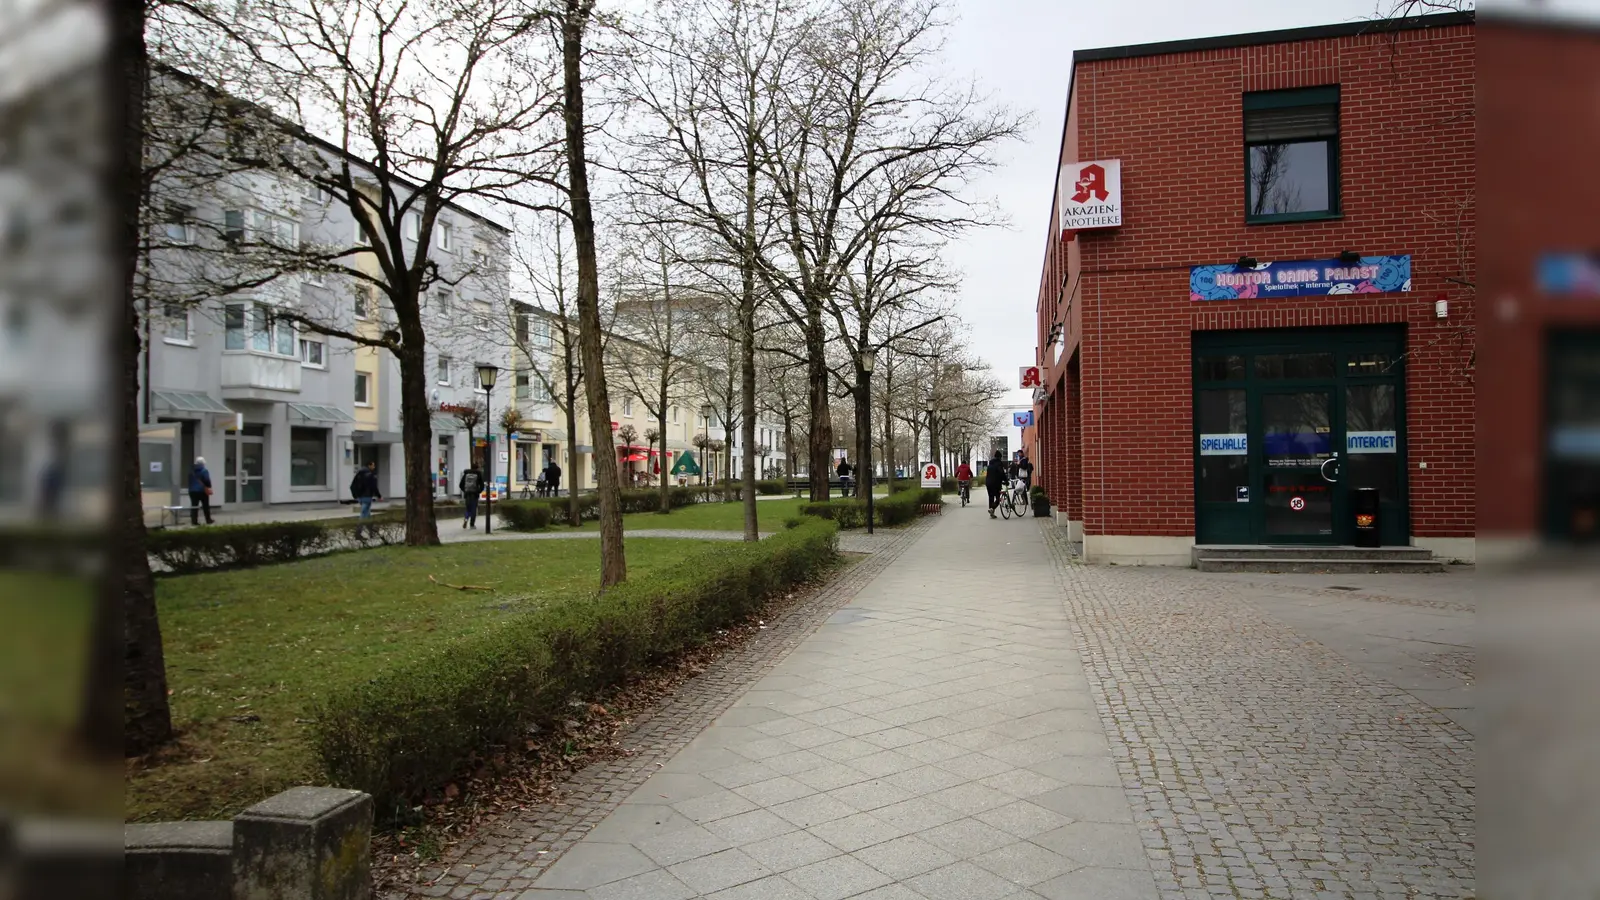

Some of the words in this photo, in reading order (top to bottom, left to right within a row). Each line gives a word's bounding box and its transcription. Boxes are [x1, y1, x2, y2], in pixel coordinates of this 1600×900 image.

[1064, 204, 1119, 217] AKAZIEN-
[1064, 215, 1120, 228] APOTHEKE
[1277, 268, 1318, 284] GAME
[1325, 265, 1379, 281] PALAST
[1264, 283, 1298, 291] Spielothek
[1201, 438, 1247, 450] SPIELHALLE
[1347, 435, 1395, 448] INTERNET
[1292, 499, 1302, 508] 18
